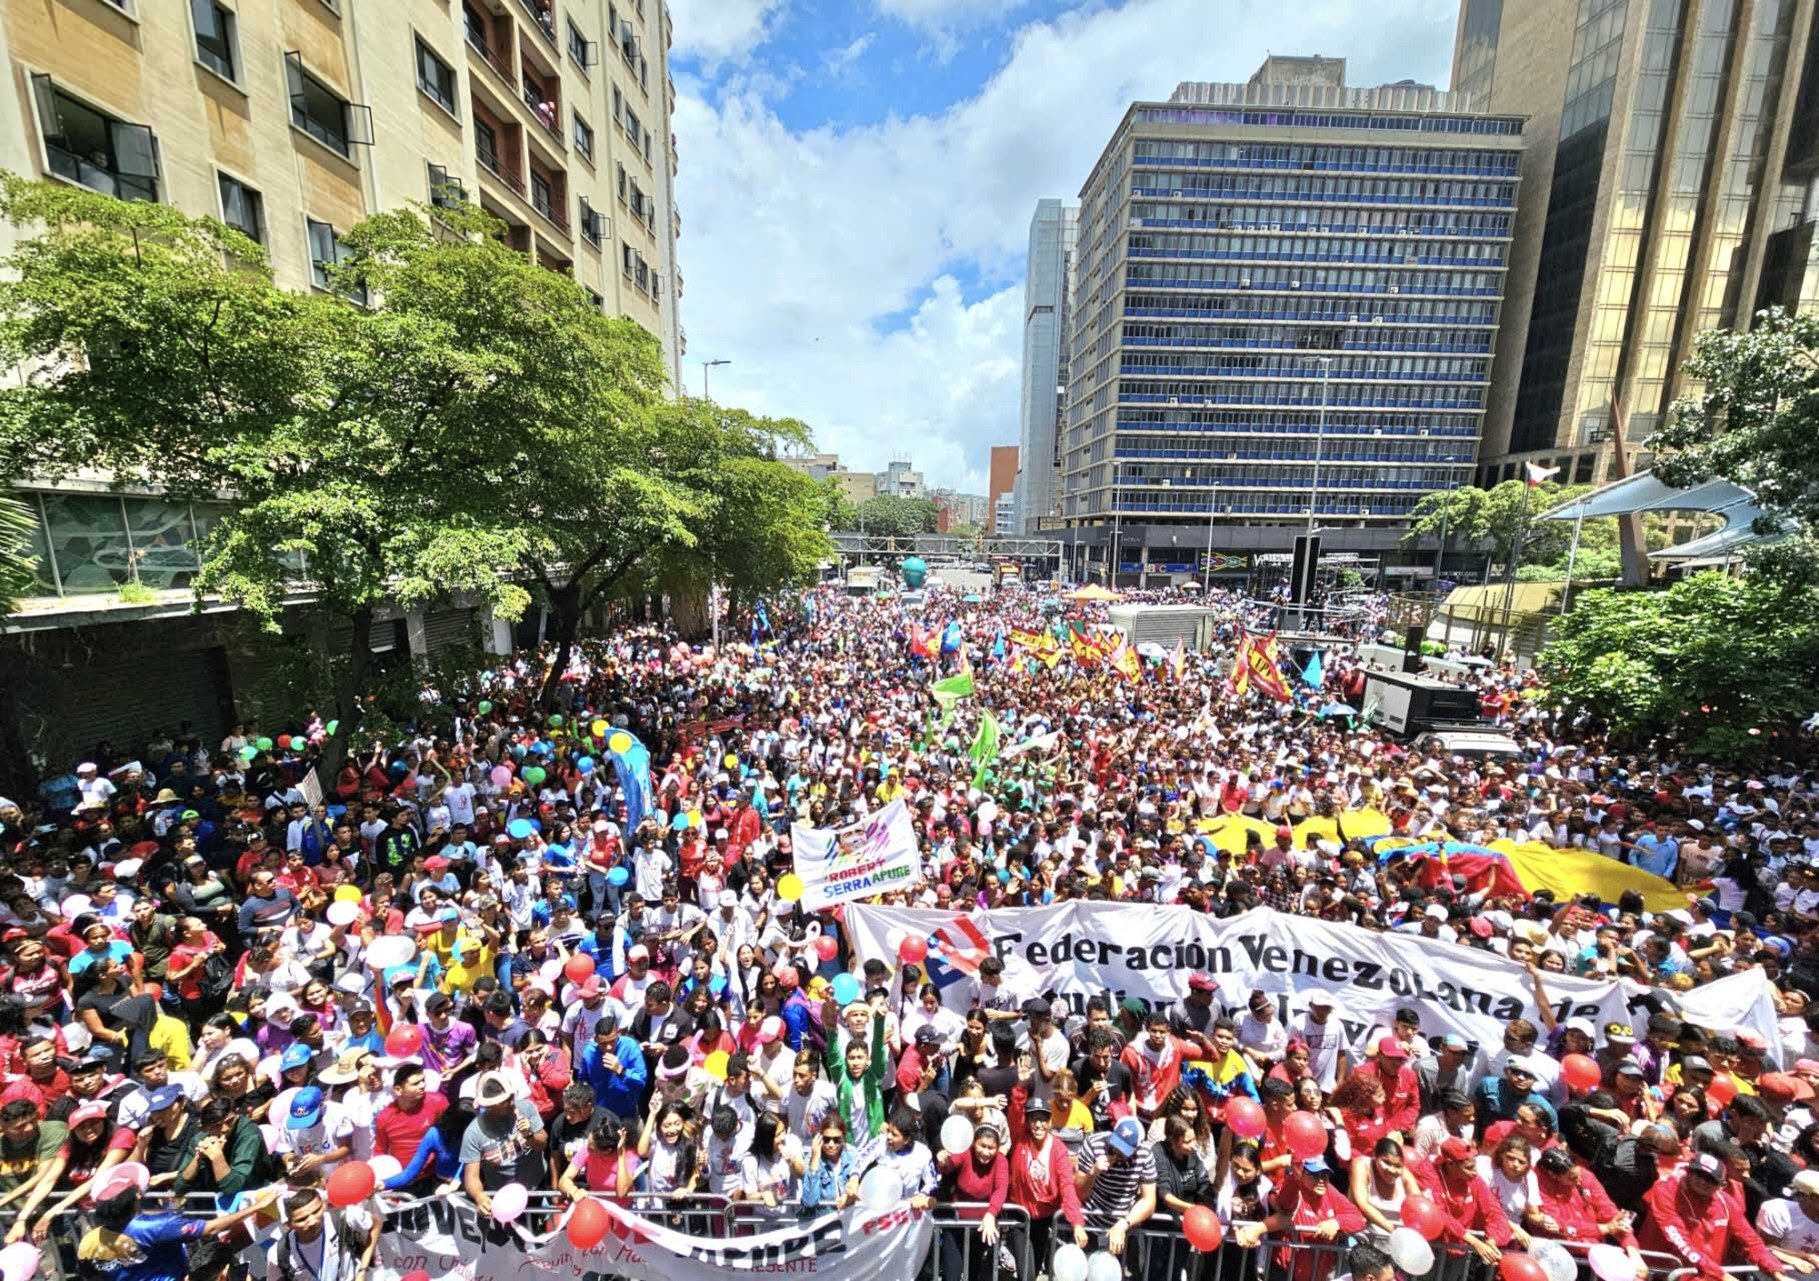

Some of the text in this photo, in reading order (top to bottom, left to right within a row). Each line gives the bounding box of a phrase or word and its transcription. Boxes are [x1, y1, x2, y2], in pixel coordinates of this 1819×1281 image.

[823, 865, 911, 898] SERRA APURE
[828, 857, 886, 883] ROBERT
[992, 932, 1233, 974] Federación
